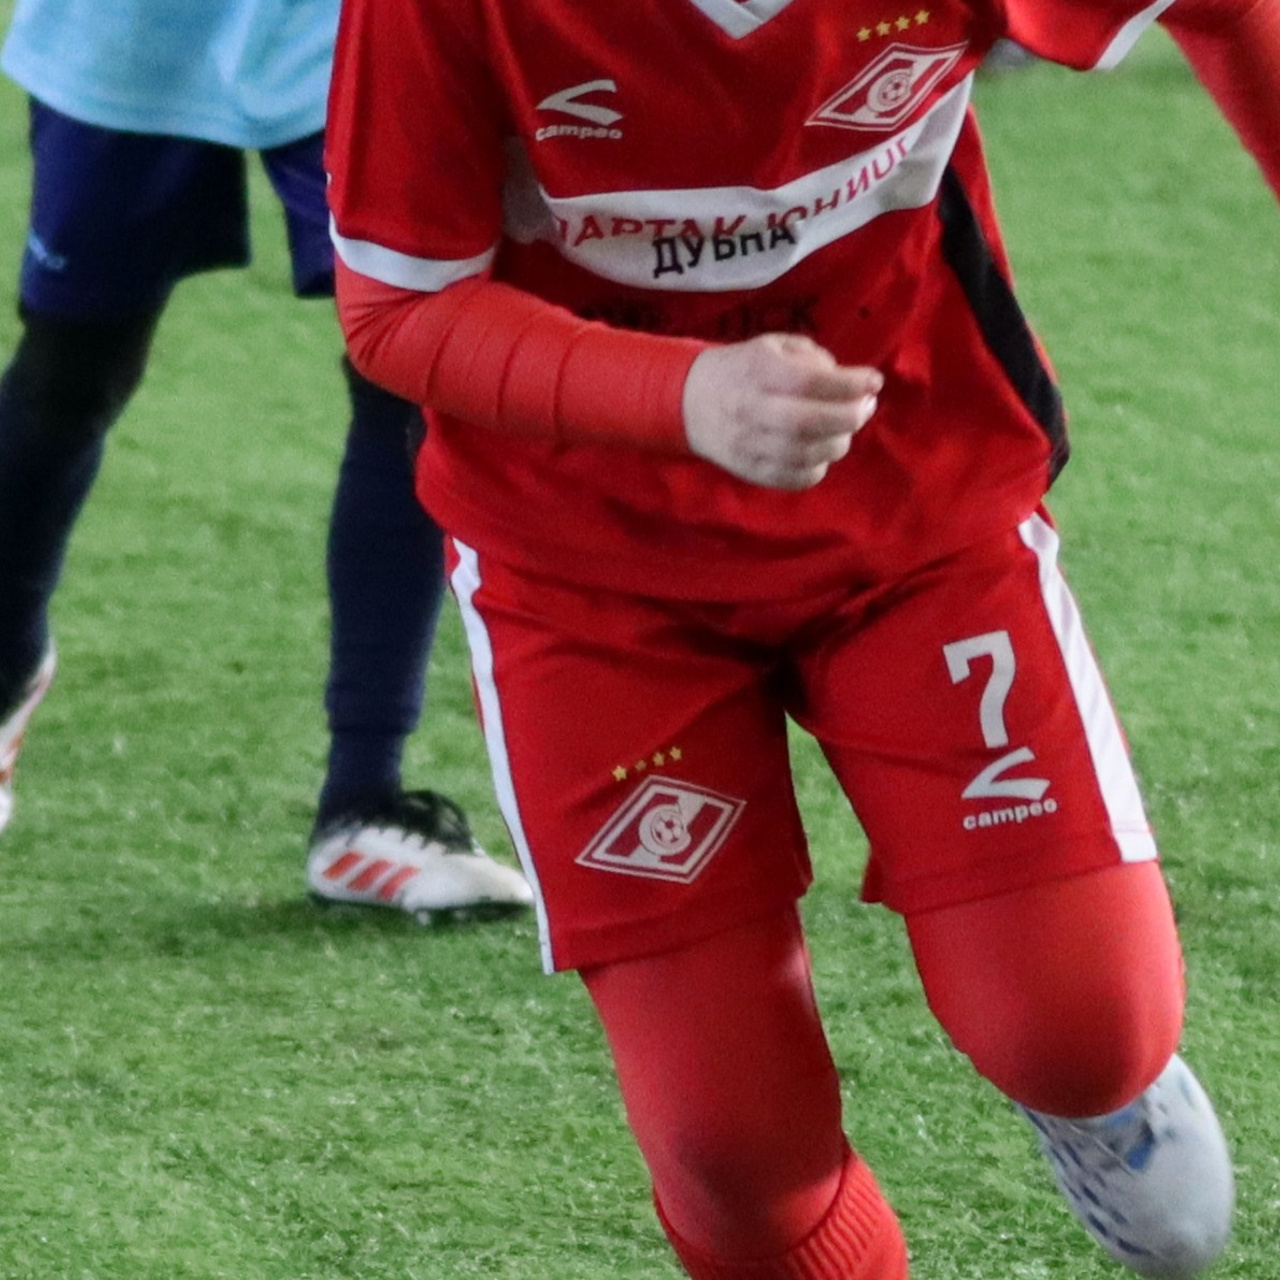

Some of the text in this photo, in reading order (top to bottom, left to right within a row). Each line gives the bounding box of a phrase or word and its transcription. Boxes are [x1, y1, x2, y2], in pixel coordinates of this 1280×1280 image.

[535, 125, 623, 141] campeo
[942, 629, 1017, 749] 7
[962, 797, 1058, 831] campeo
